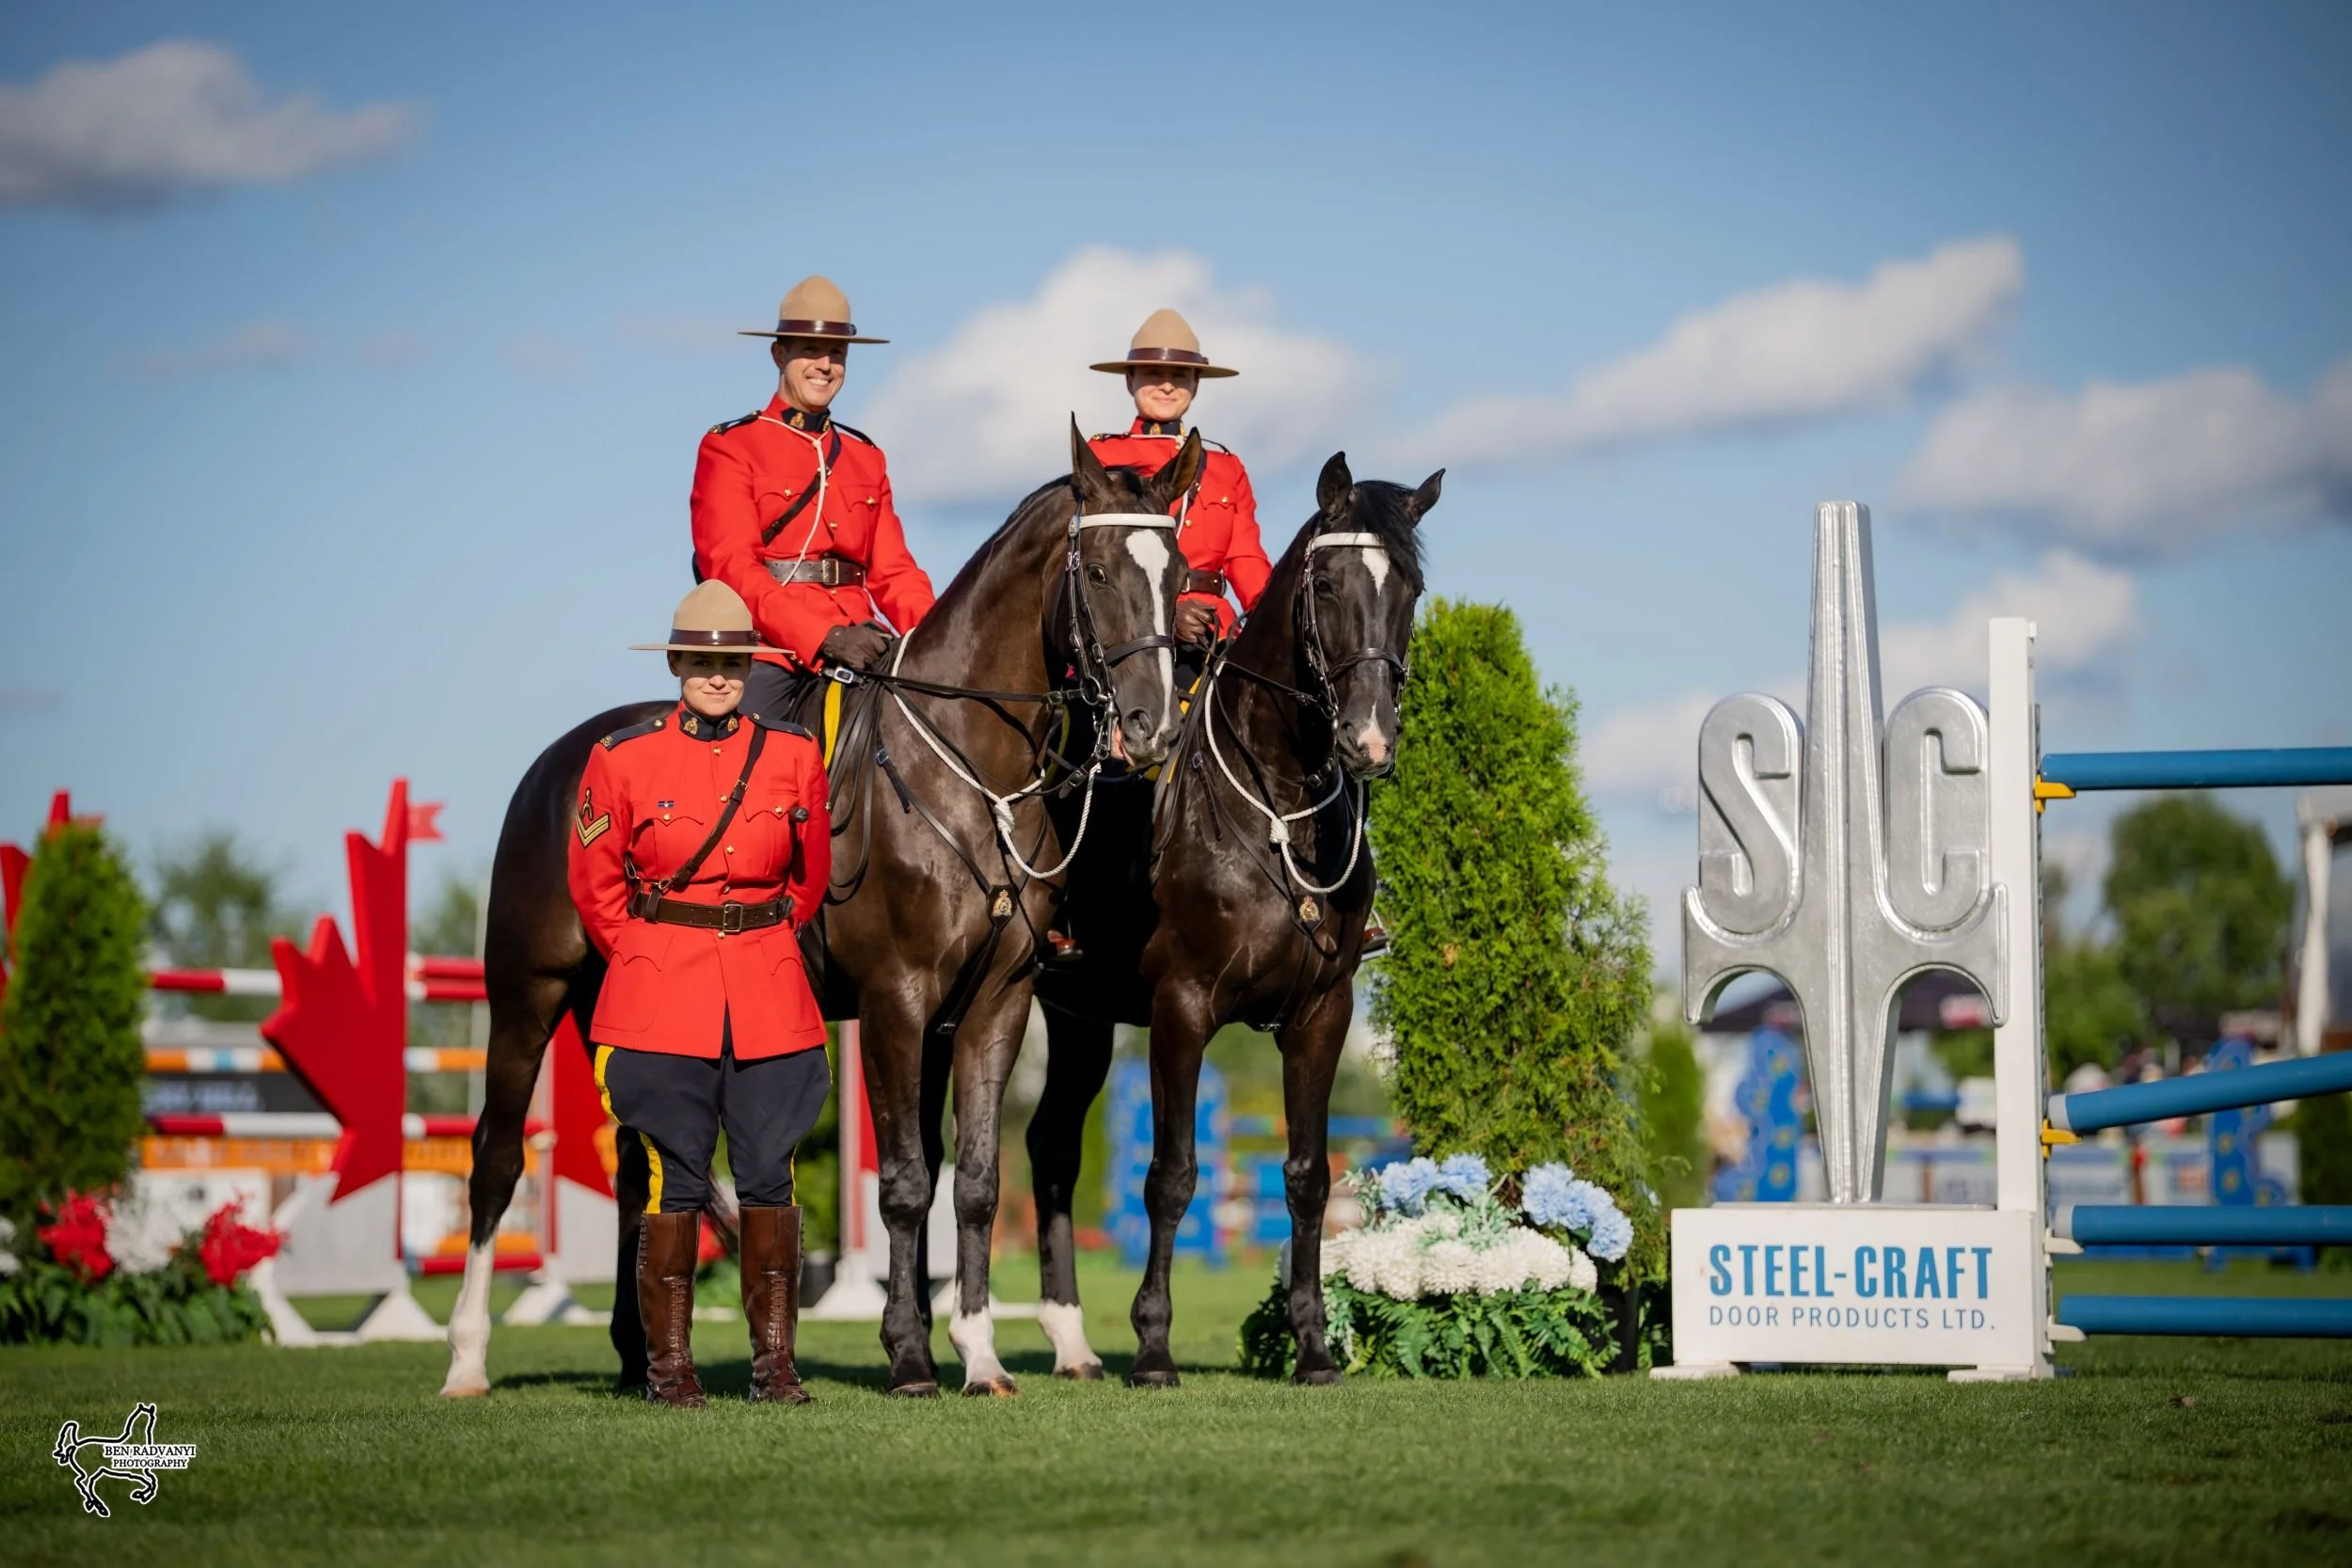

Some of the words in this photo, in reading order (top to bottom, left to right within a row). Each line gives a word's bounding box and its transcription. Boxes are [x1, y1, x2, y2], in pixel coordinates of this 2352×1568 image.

[1709, 1243, 1993, 1299] STEEL-CRAFT
[1710, 1306, 1779, 1326] DOOR
[1792, 1307, 1930, 1329] PRODUCTS
[1943, 1308, 1995, 1330] LTD.
